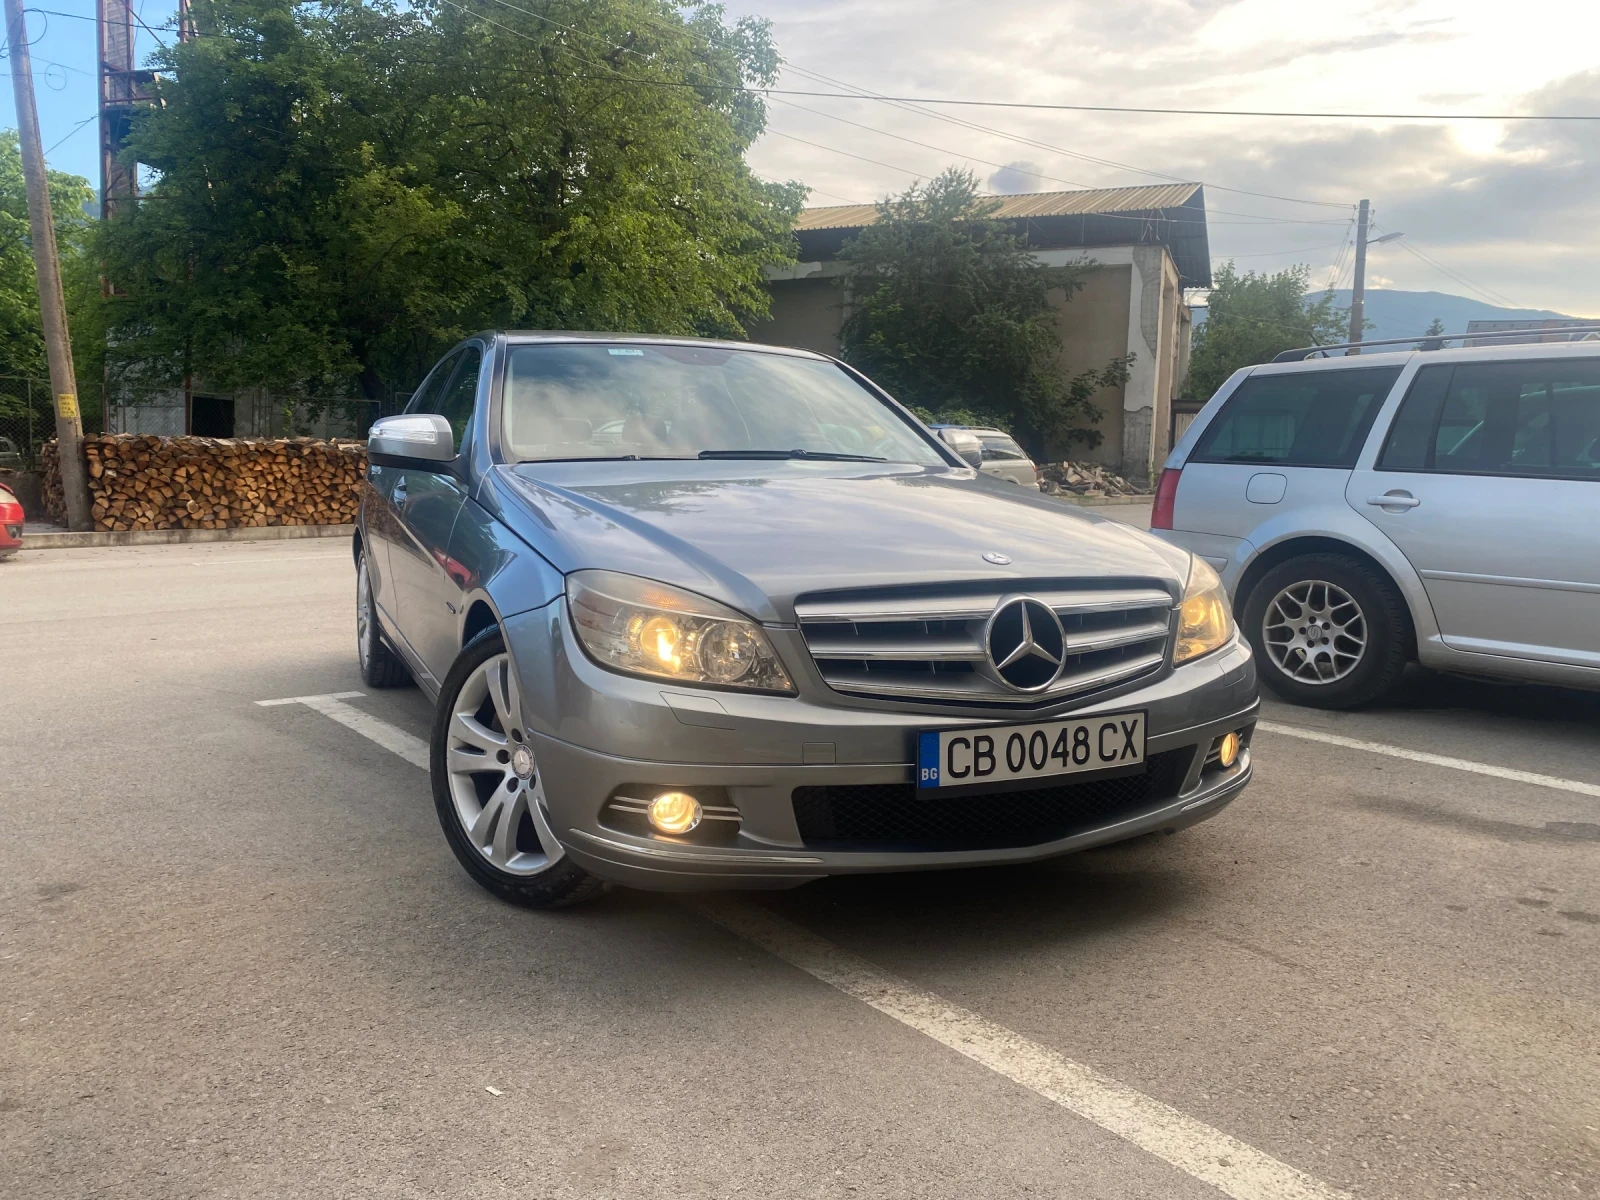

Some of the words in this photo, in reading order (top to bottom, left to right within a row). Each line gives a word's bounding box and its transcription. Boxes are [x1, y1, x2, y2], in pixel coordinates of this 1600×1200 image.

[947, 735, 996, 778] CB
[1006, 726, 1090, 772] 0048
[1098, 719, 1138, 762] CX
[921, 767, 938, 781] BG
